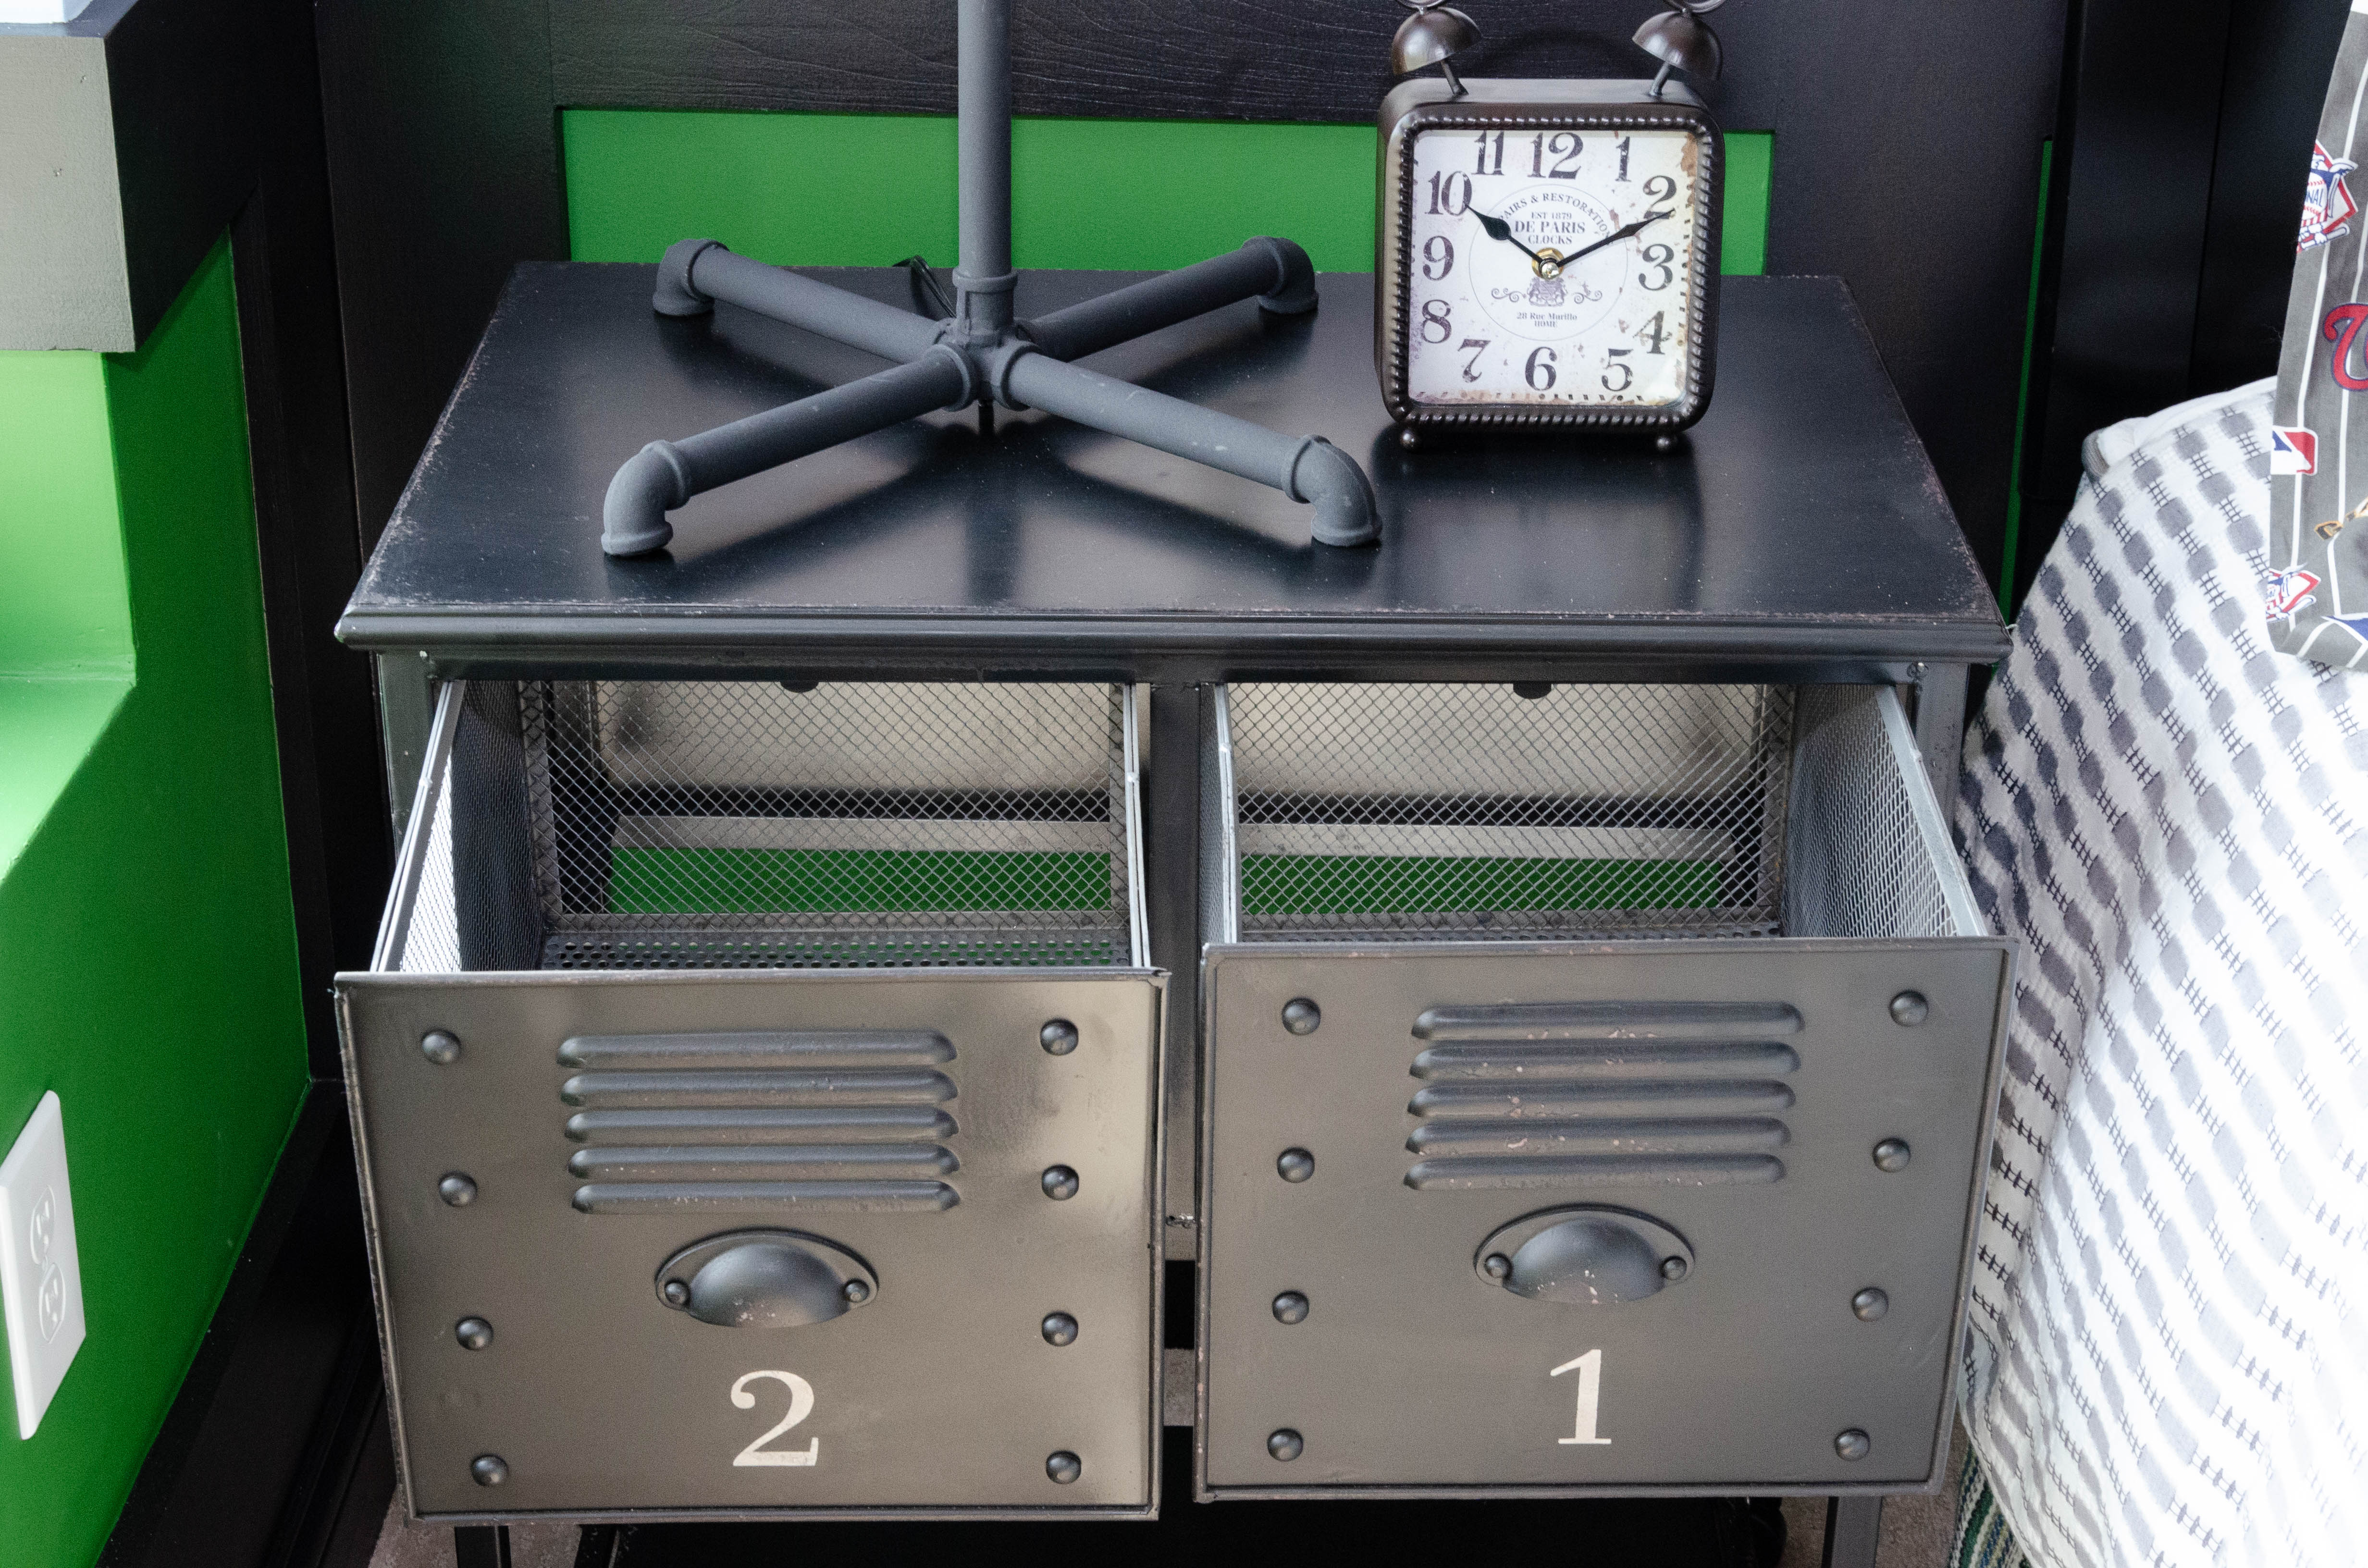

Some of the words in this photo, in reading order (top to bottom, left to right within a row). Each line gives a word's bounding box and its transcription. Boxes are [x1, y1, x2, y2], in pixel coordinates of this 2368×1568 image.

[1472, 131, 1504, 176] 11
[1527, 132, 1583, 180] 12
[1615, 136, 1631, 182] 1
[1425, 171, 1472, 216] 10
[1531, 195, 1539, 204] &
[1552, 211, 1572, 220] 1879
[1642, 175, 1677, 220] 2
[1514, 220, 1535, 233] DE
[1540, 221, 1585, 233] PARIS
[1528, 235, 1573, 245] CLOCKS
[1422, 235, 1454, 281] 9
[1639, 244, 1675, 291] 3
[1420, 299, 1452, 344] 8
[1633, 311, 1672, 355] 4
[1457, 339, 1491, 383] 7
[1525, 347, 1557, 391] 6
[1601, 348, 1633, 391] 5
[731, 1370, 819, 1467] 2
[1550, 1349, 1612, 1444] 1
